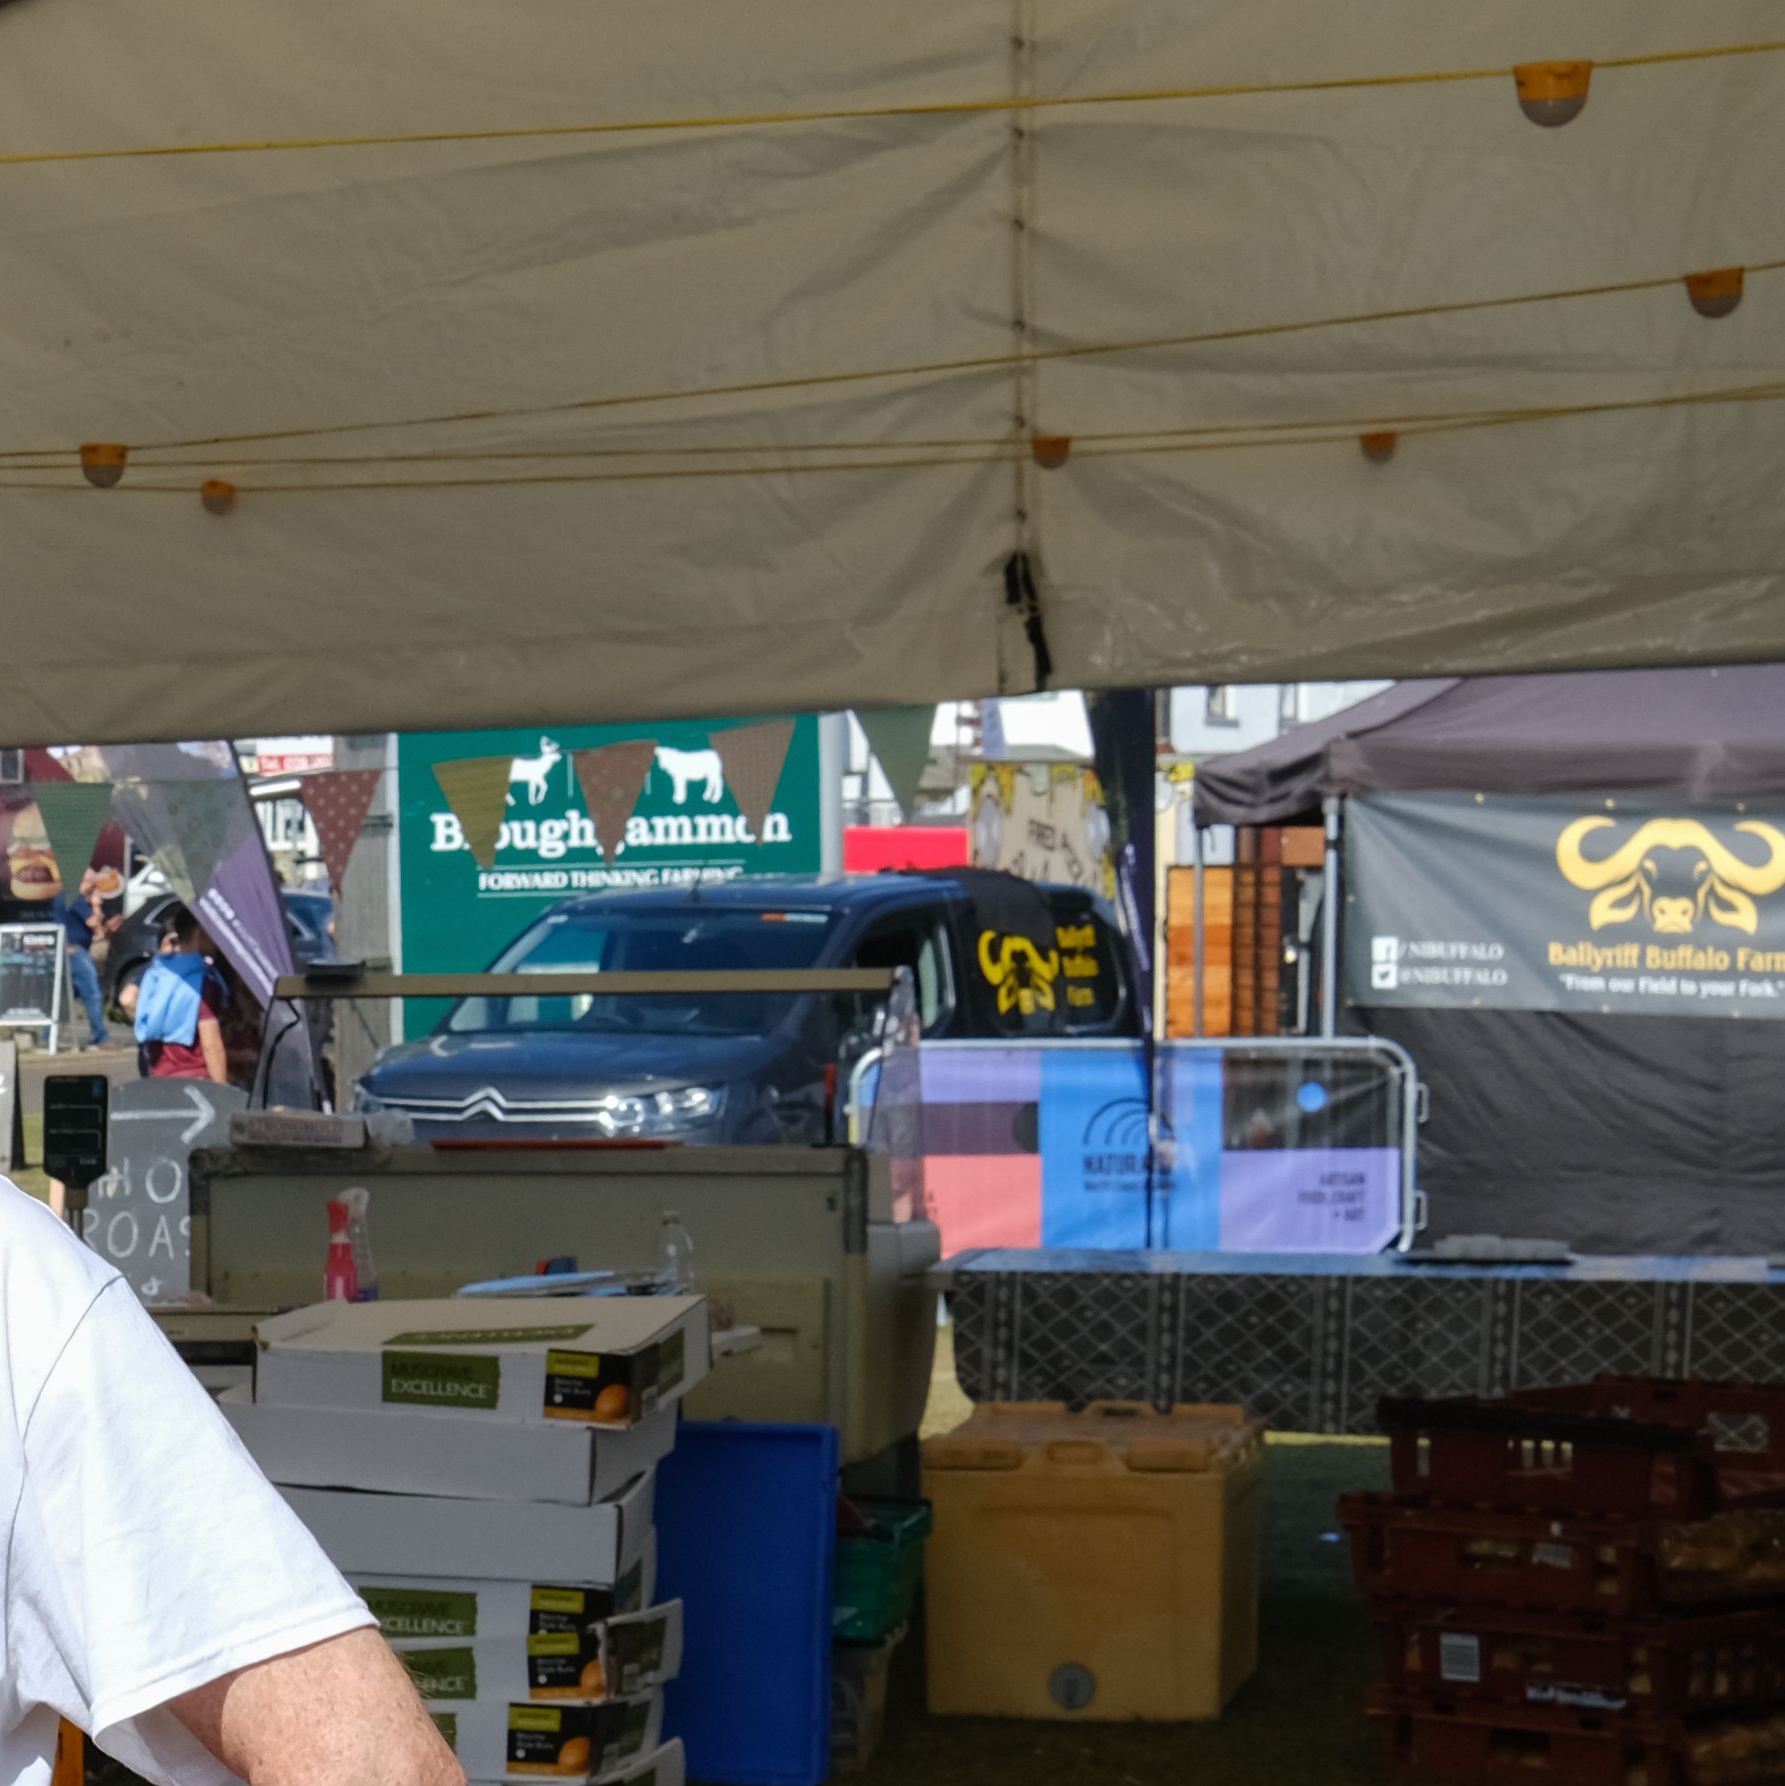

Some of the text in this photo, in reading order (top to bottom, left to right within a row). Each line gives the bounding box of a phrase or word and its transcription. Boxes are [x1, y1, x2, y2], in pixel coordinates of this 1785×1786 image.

[479, 872, 568, 889] FORWARD
[571, 869, 659, 887] THINKING
[1645, 943, 1729, 971] Buffalo
[1639, 976, 1677, 994] Field
[1680, 978, 1697, 995] to
[1700, 979, 1735, 998] your
[98, 1156, 182, 1203] HO
[391, 1379, 487, 1398] EXCELLENCE
